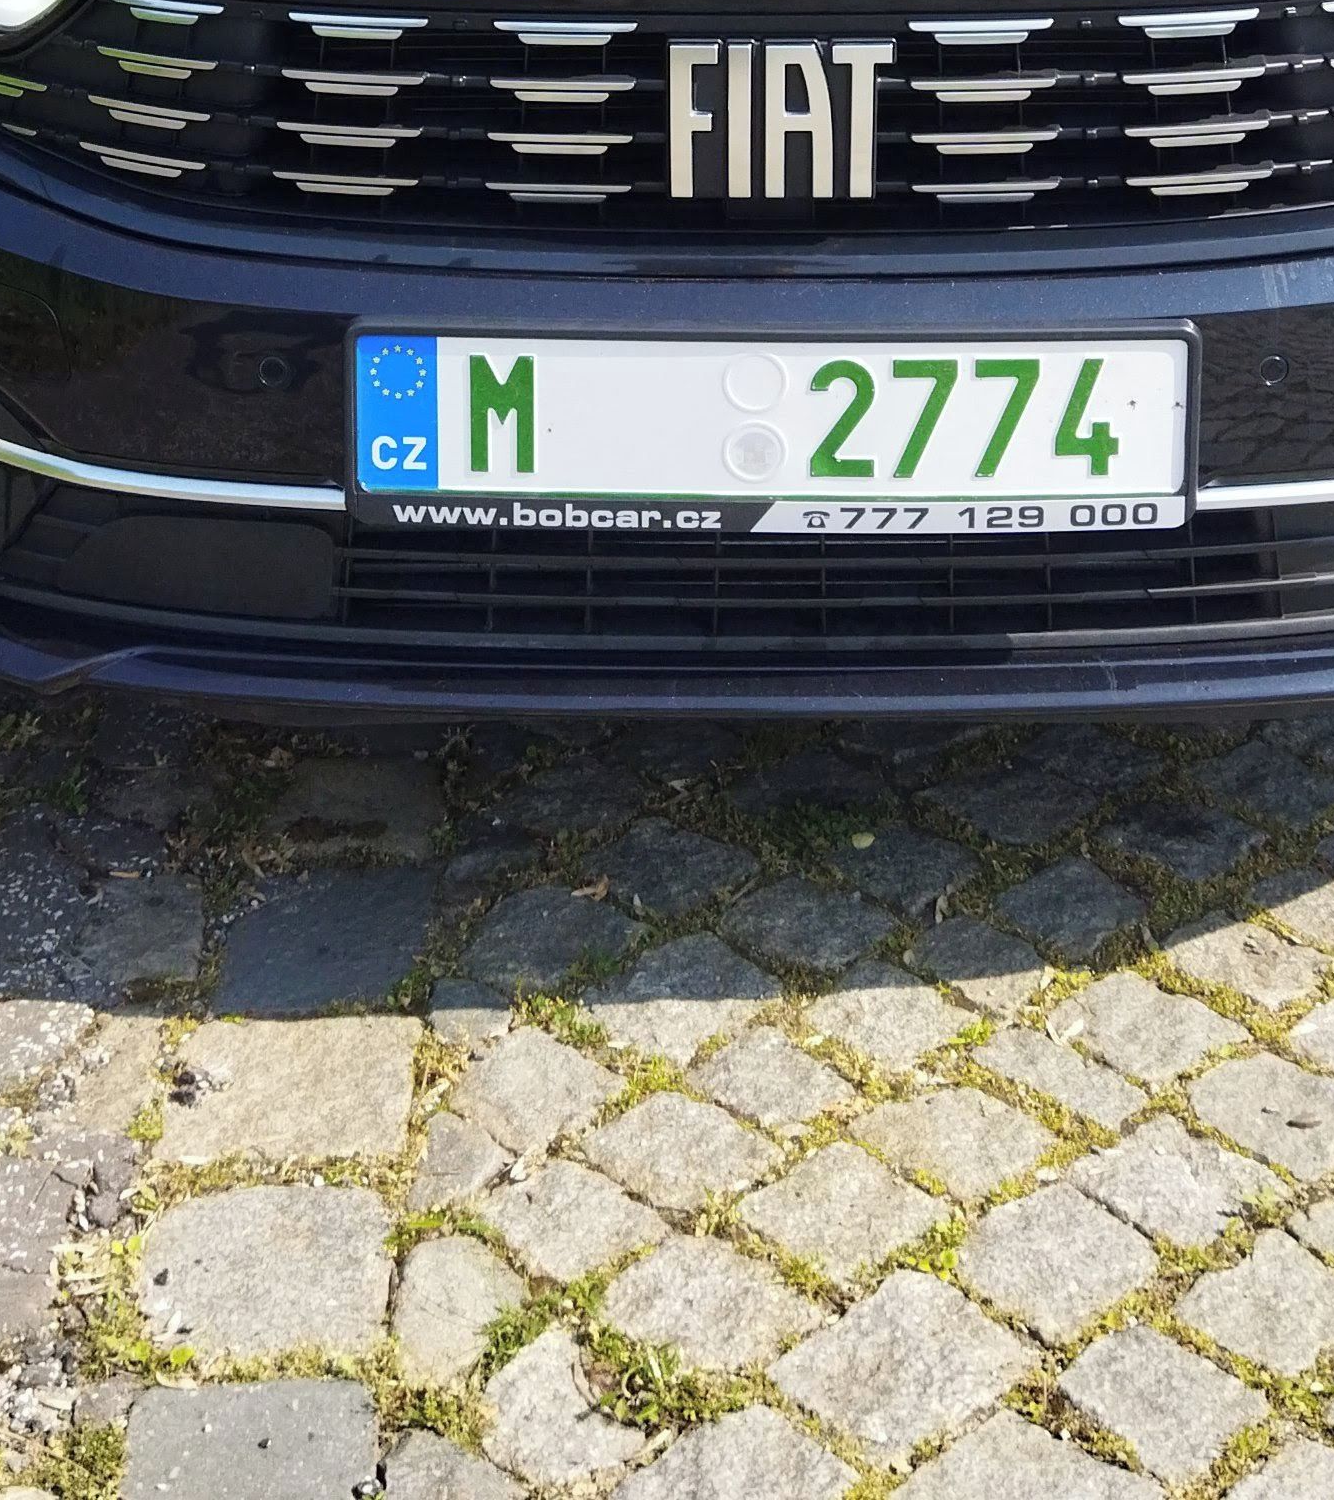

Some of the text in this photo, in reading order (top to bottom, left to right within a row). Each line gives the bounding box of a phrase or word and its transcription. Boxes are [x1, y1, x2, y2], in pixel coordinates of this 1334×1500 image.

[668, 40, 895, 198] FIAT
[469, 354, 1119, 478] M 2774
[371, 435, 427, 470] CZ
[392, 502, 722, 529] www.bobcar.cz
[839, 502, 1158, 530] 777 129 000
